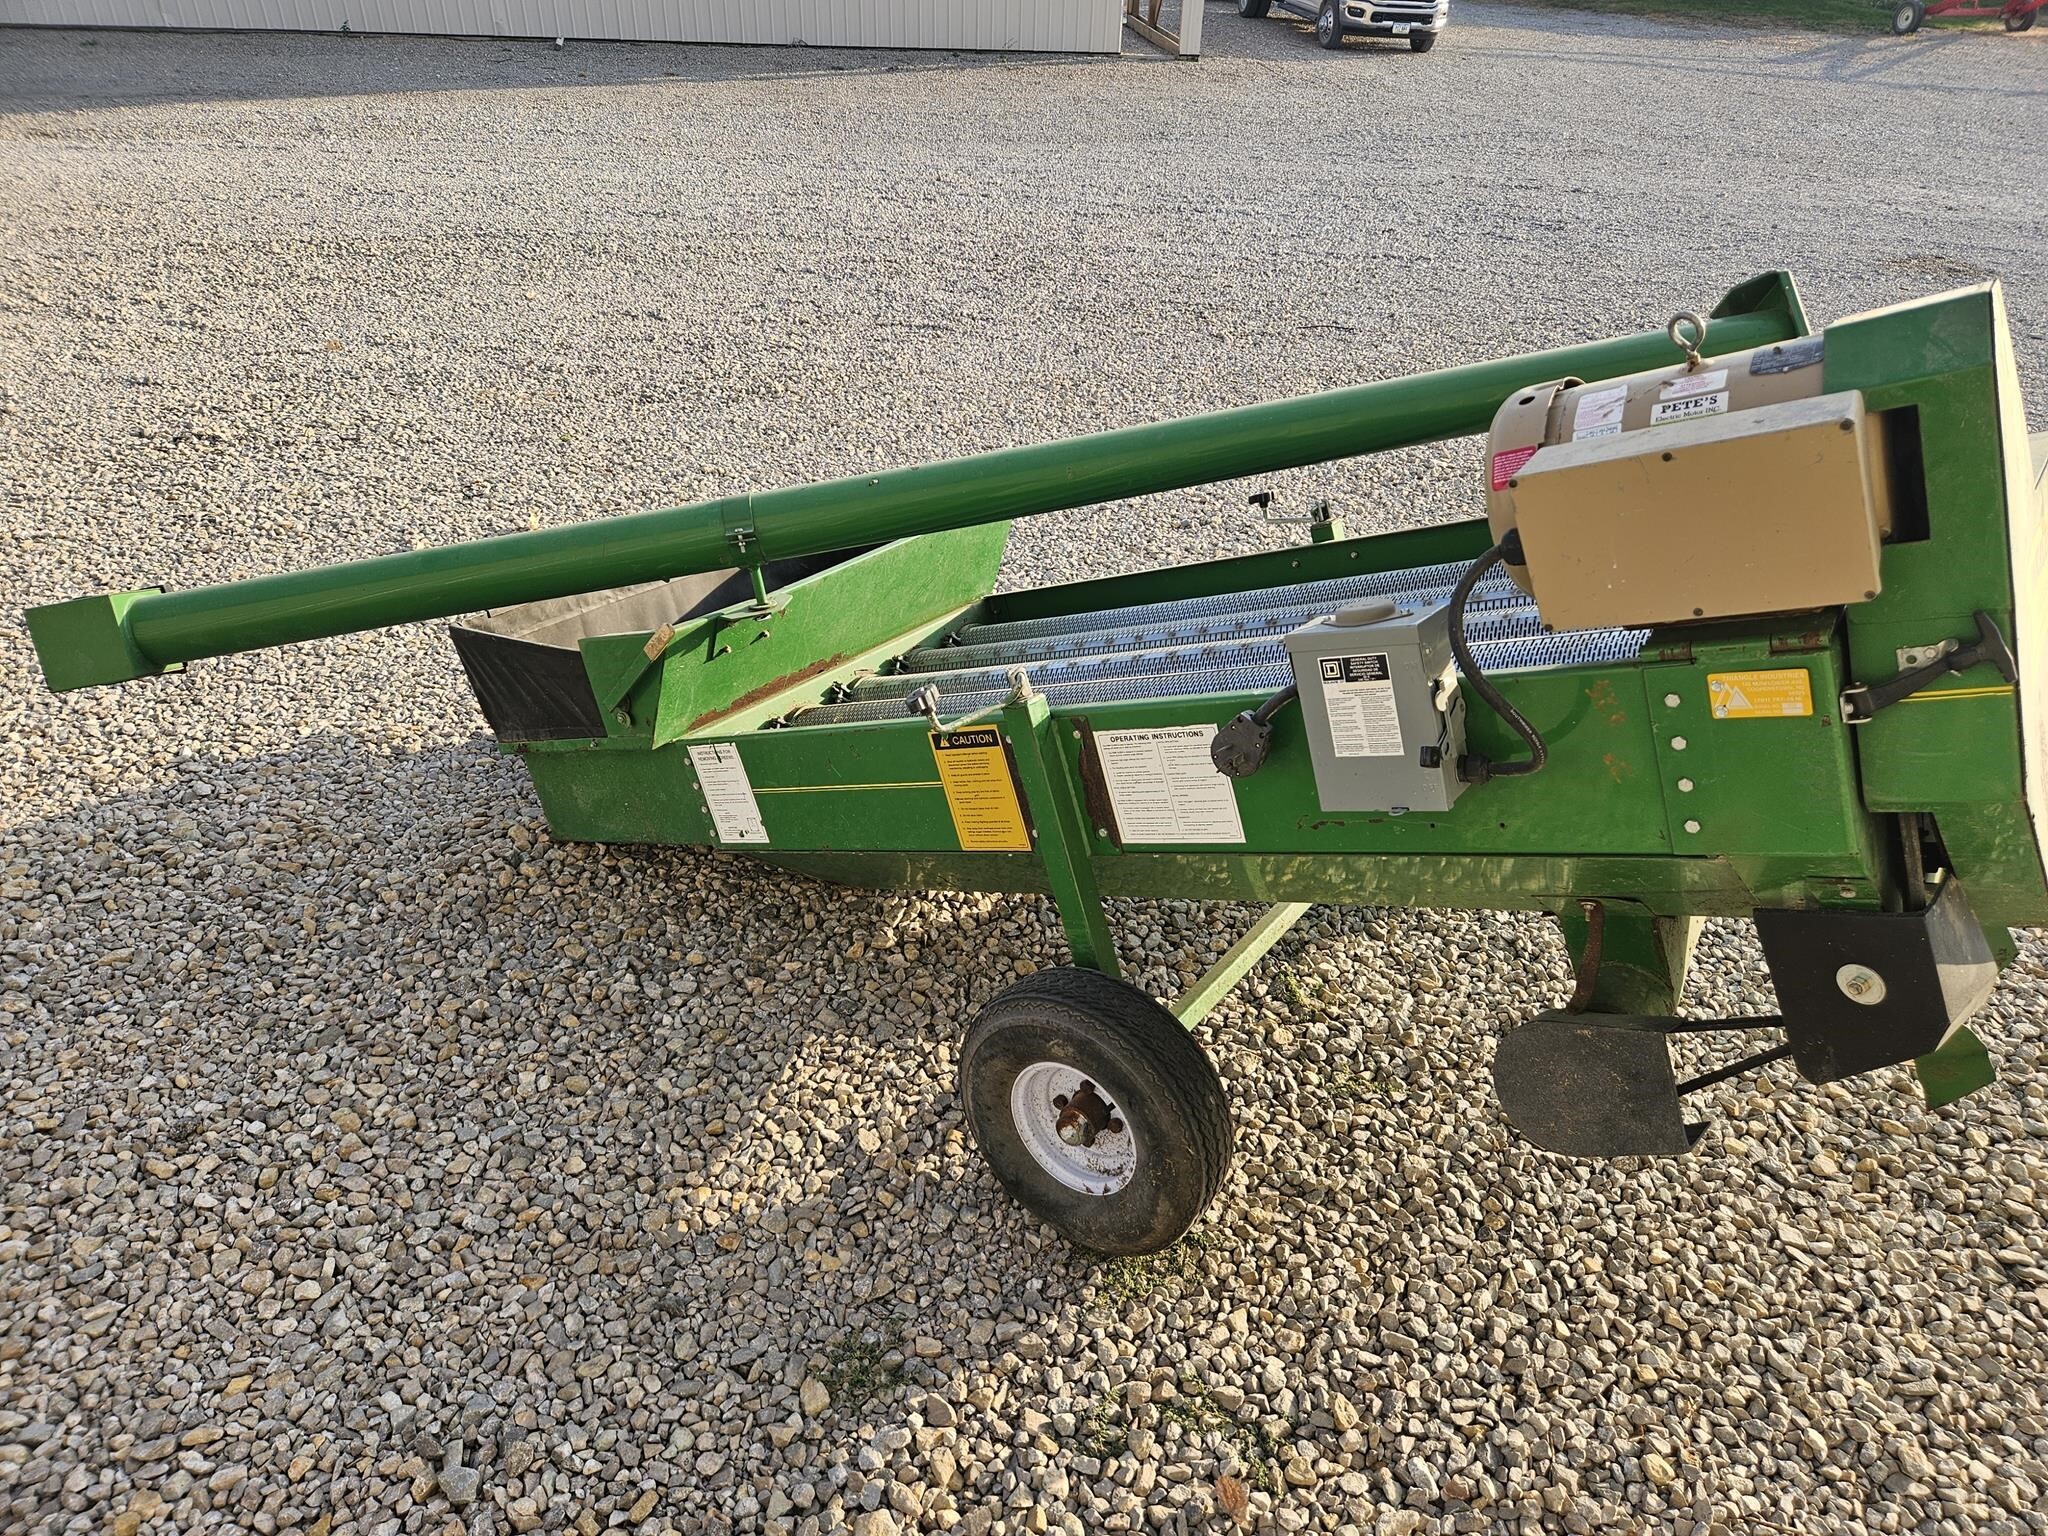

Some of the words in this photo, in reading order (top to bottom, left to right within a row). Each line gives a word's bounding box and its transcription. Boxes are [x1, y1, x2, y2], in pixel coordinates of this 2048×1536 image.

[1661, 395, 1718, 414] PETE'S
[1655, 414, 1682, 423] Electric
[1683, 410, 1703, 418] Motor
[952, 734, 993, 746] CAUTION
[1110, 732, 1150, 743] OPERATING
[1151, 730, 1204, 741] INSTRUCTIONS
